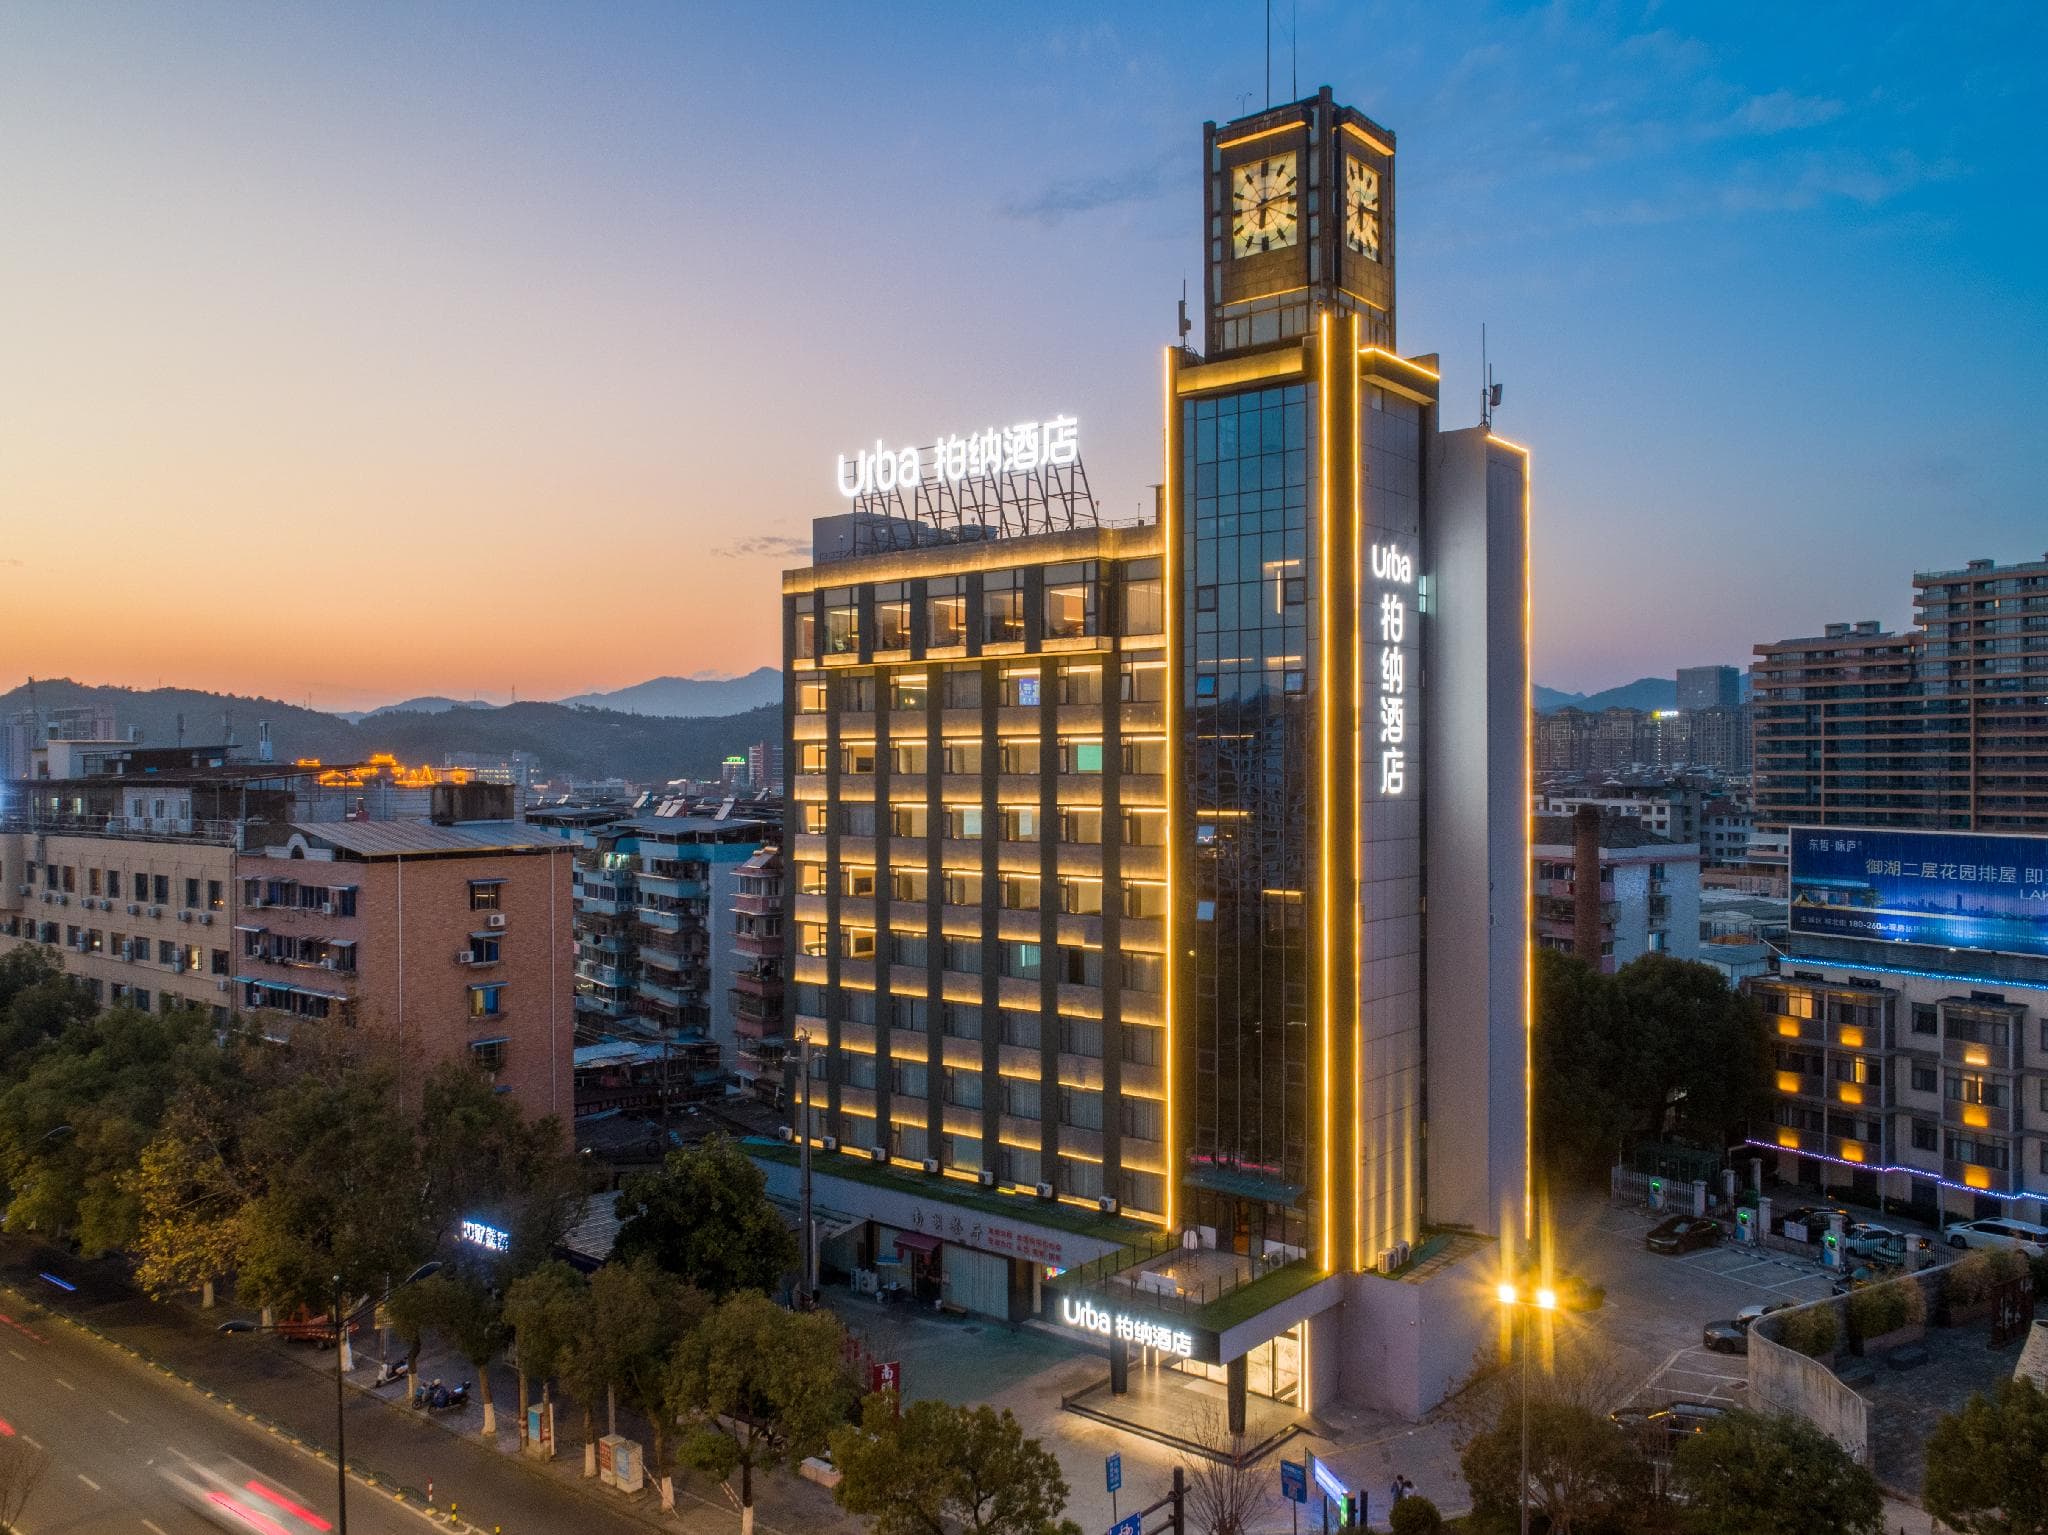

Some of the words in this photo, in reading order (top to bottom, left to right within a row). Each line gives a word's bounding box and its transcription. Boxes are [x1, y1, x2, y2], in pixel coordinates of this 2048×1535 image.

[838, 439, 920, 497] Urba
[934, 415, 1078, 482] 柏纳酒店
[1372, 544, 1411, 584] Urba
[1380, 594, 1404, 794] 柏纳酒店
[1865, 858, 2017, 884] 御湖二层花园排屋
[2025, 867, 2048, 886] 即
[1063, 1298, 1111, 1334] Urba
[1116, 1314, 1192, 1357] 柏纳酒店
